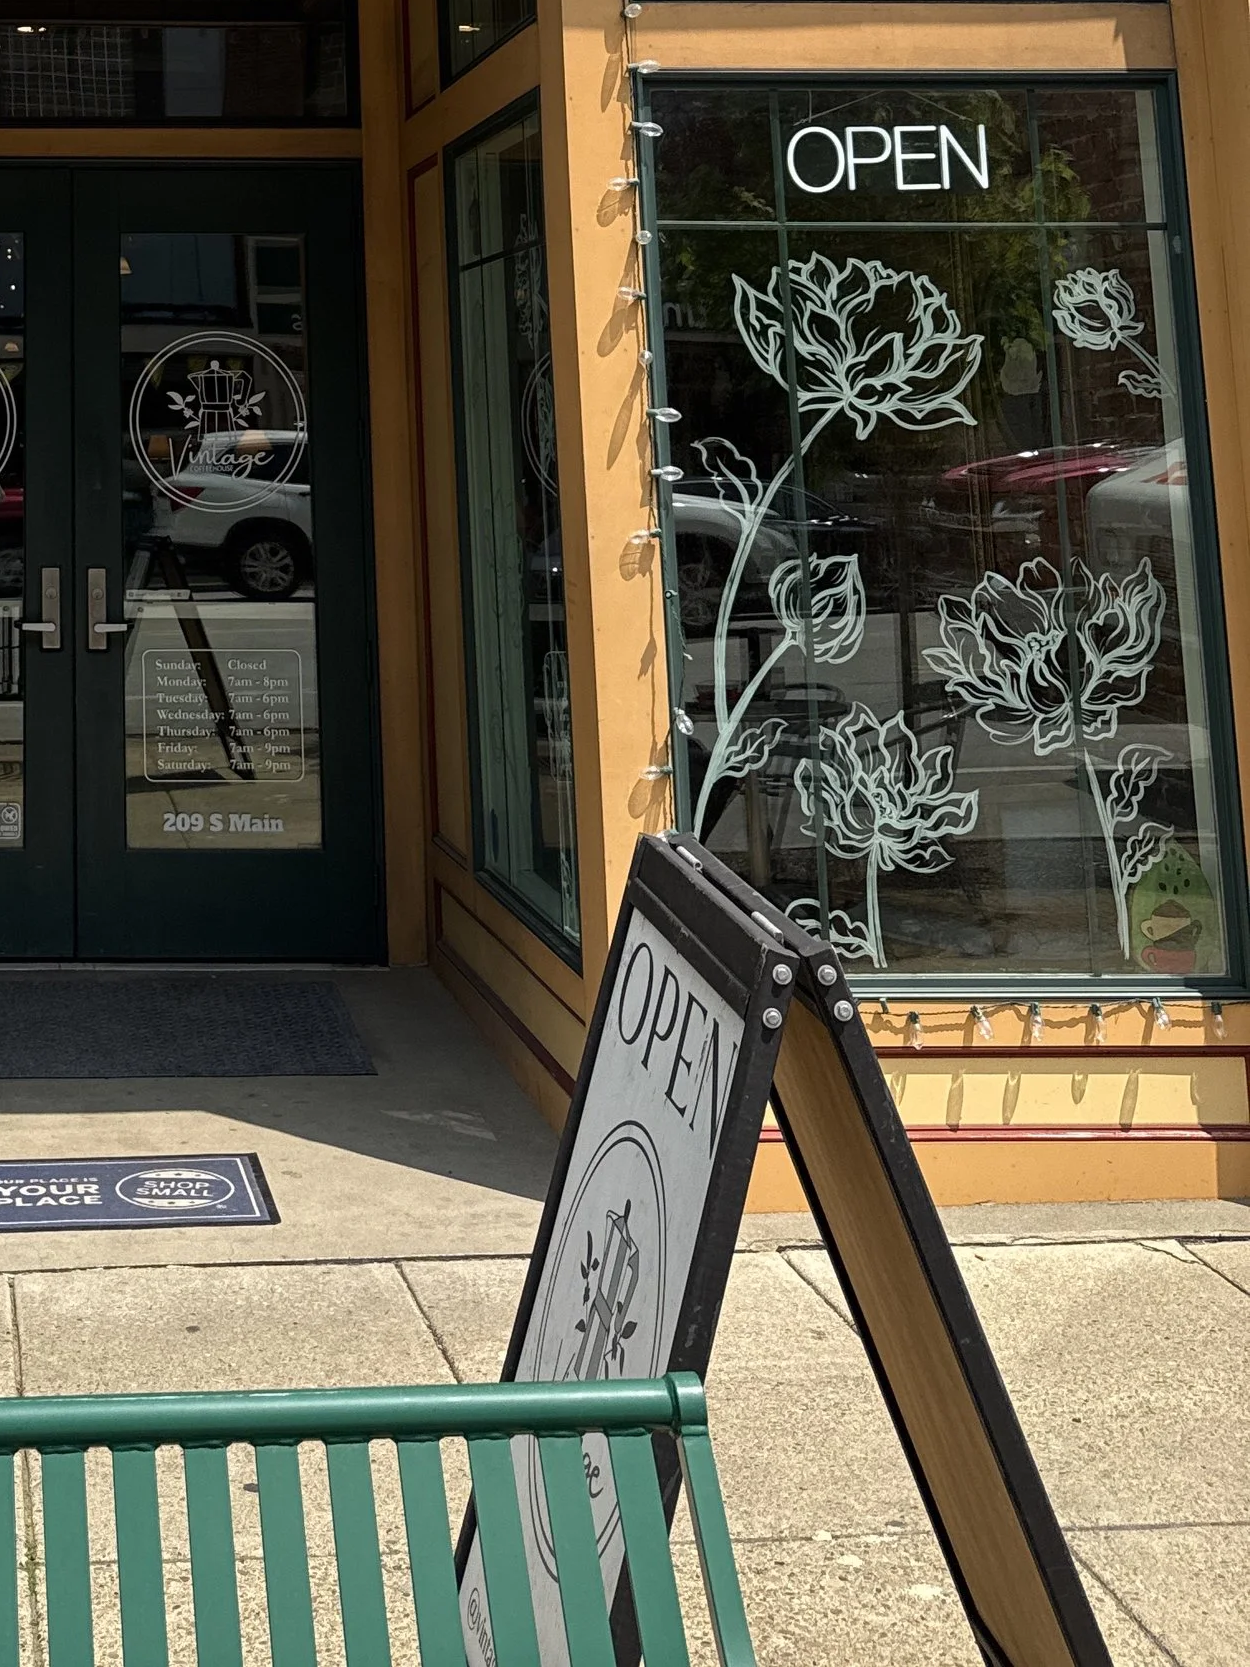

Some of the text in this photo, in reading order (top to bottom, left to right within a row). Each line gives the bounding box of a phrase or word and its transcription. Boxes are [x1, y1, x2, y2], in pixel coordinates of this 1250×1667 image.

[786, 123, 990, 194] OPEN
[169, 434, 275, 480] Vintage
[155, 659, 267, 672] Sunday: Closed
[157, 676, 207, 688] Monday:
[227, 676, 252, 686] 7am
[263, 676, 289, 688] 8pm
[157, 693, 208, 705] Tuesday:
[228, 693, 253, 703] 7am
[262, 693, 289, 705] 6pm
[157, 709, 225, 722] Wednesday:
[228, 710, 253, 720] 7am
[263, 710, 290, 722] 6pm
[157, 726, 216, 738] Thursday:
[229, 727, 254, 737] 7am
[263, 727, 290, 739] 6pm
[157, 743, 198, 755] Friday:
[230, 743, 254, 753] 7am
[265, 743, 291, 755] 9pm
[157, 759, 211, 772] Saturday:
[230, 760, 254, 770] 7am
[265, 760, 291, 772] 9pm
[163, 813, 284, 832] 209 S Main
[616, 942, 739, 1161] OPEN
[143, 1180, 211, 1190] SHOP
[135, 1188, 214, 1197] SMALL
